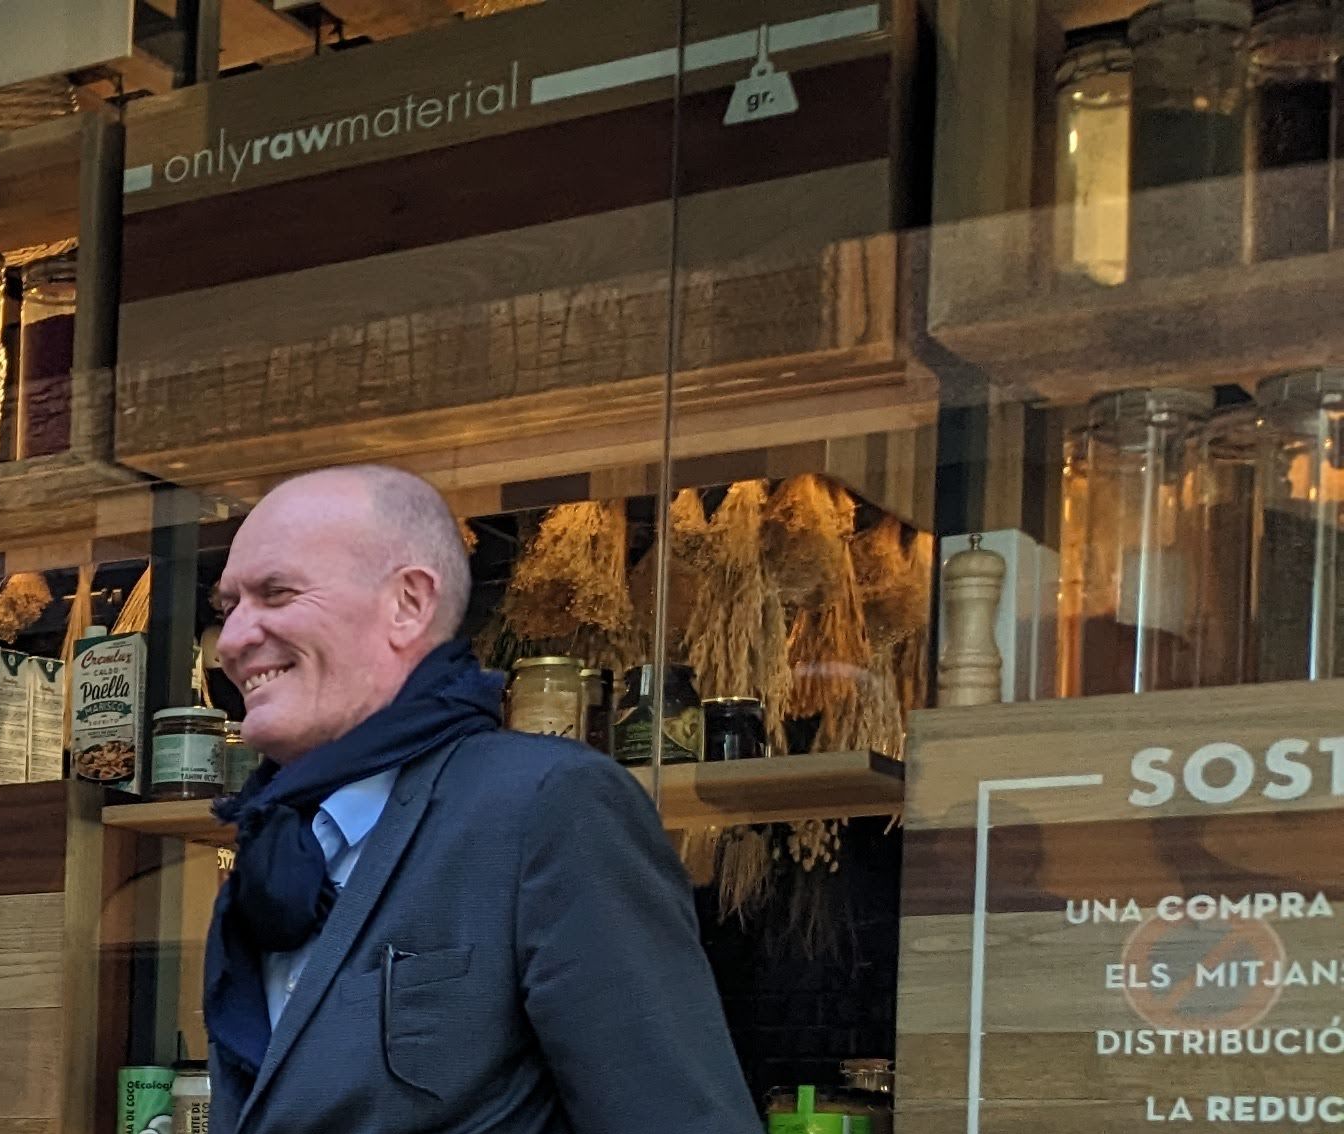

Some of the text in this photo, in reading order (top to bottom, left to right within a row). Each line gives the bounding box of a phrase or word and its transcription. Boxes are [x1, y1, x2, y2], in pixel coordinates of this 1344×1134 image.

[745, 86, 776, 112] gr.
[164, 61, 518, 183] onlyrawmaterial
[80, 674, 130, 703] Paella
[1065, 891, 1335, 924] UNA COMPRA
[1105, 959, 1344, 989] ELS MITJAN
[1097, 1016, 1344, 1055] DISTRIBUCIÓ
[126, 1081, 135, 1107] COCO
[126, 1110, 135, 1122] DE
[191, 1102, 201, 1115] DE
[1146, 1095, 1344, 1123] LA REDUC
